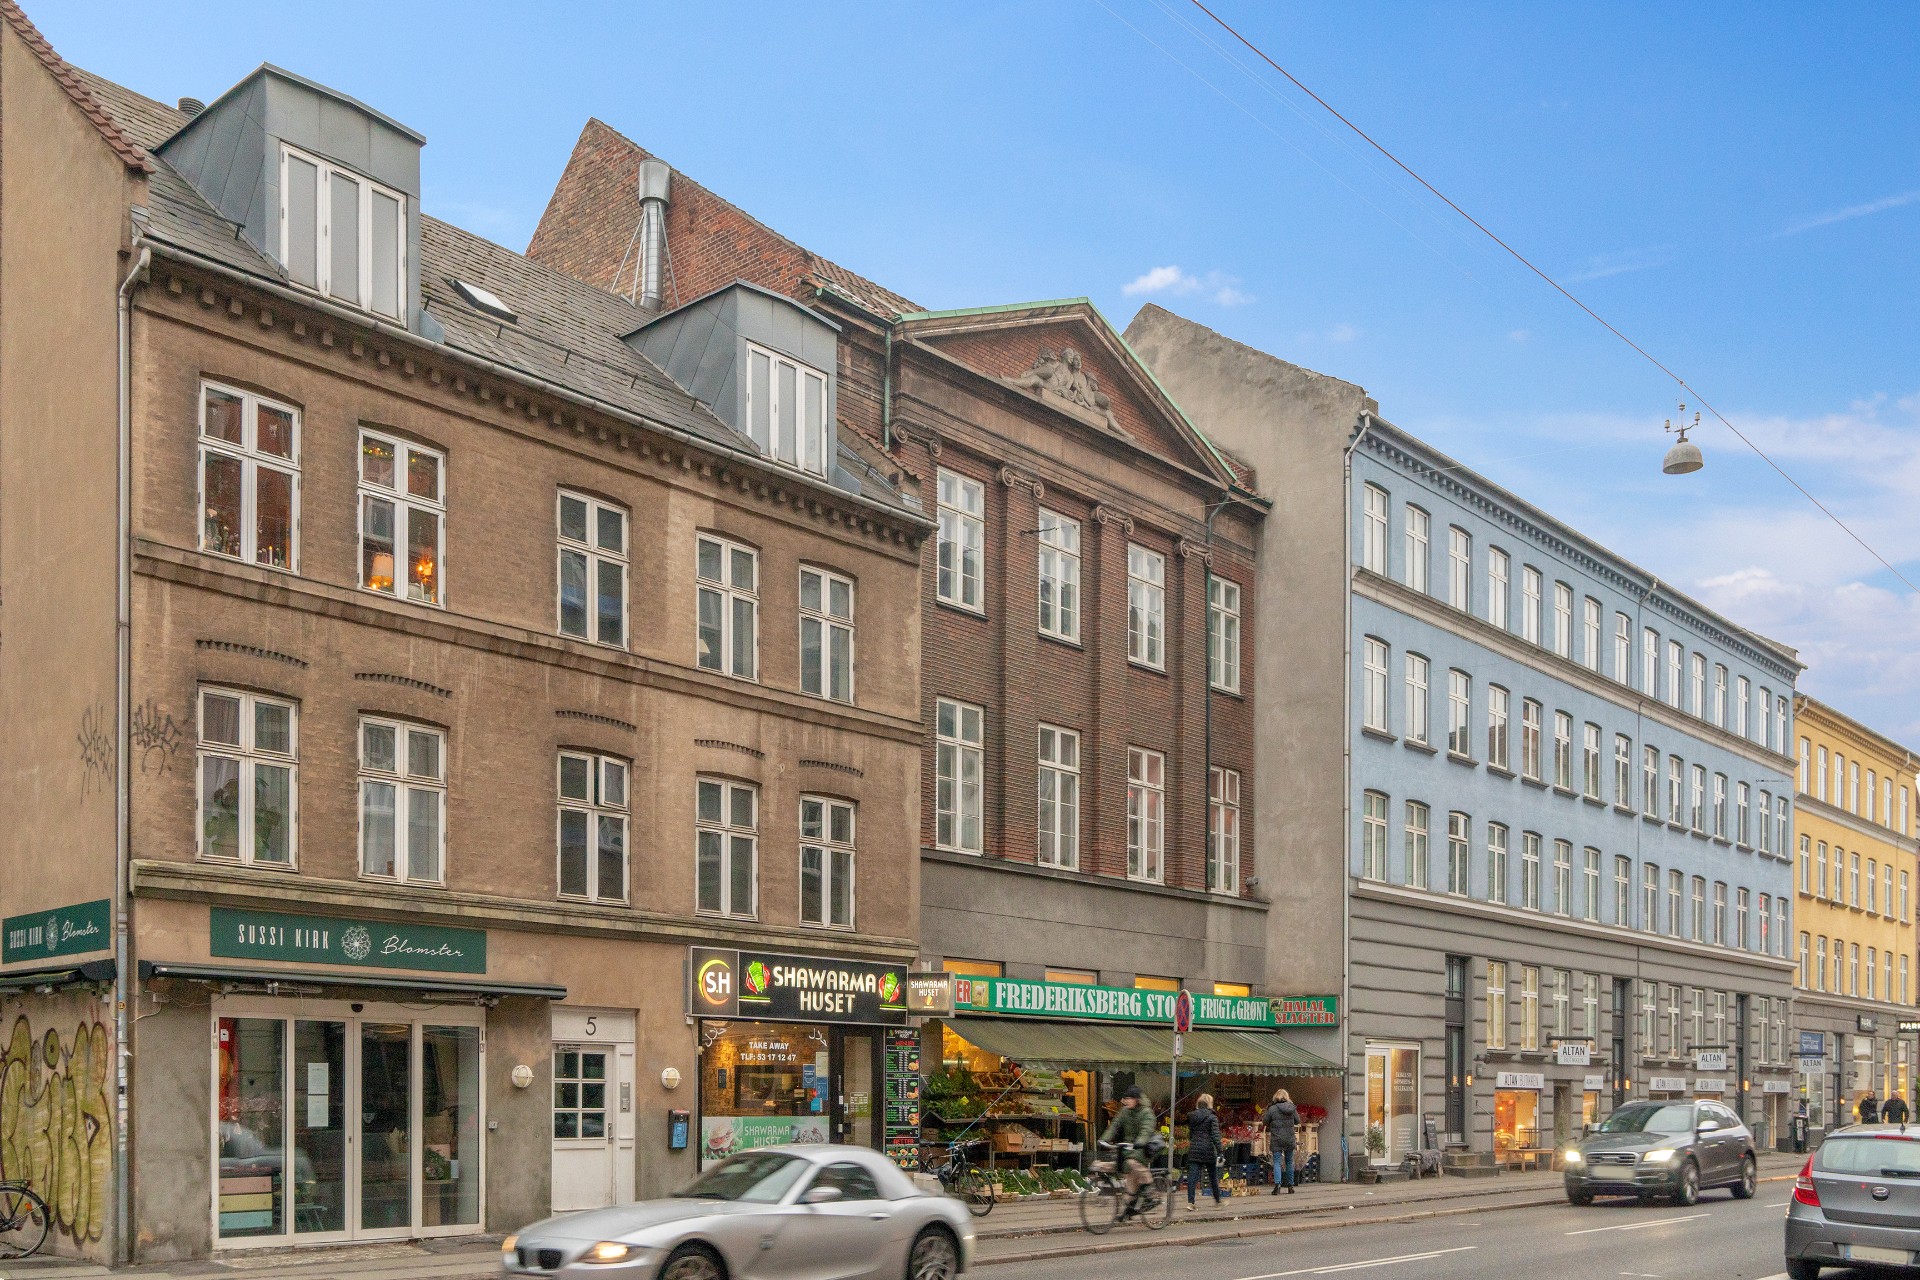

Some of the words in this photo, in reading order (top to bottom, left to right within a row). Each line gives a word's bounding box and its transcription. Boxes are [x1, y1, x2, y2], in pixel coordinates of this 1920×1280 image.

[61, 920, 99, 942] Blomster
[238, 923, 284, 946] SUSSI
[295, 928, 329, 950] KIRK
[380, 934, 464, 957] Blomster
[773, 966, 876, 993] SHAWARMA
[910, 980, 948, 990] SHAWARMA
[918, 988, 939, 998] HUSET
[800, 990, 856, 1013] HUSET
[995, 981, 1142, 1018] FREDERIKSBERG
[1283, 1000, 1326, 1012] HALAL
[1275, 1012, 1335, 1025] SLAGTER
[585, 1016, 597, 1036] 5
[749, 1041, 768, 1050] TAKE
[769, 1042, 790, 1050] AWAY
[1562, 1046, 1585, 1056] ALTAN
[741, 1053, 756, 1061] TLF:
[757, 1053, 766, 1061] 53
[767, 1053, 776, 1061] 17
[777, 1053, 786, 1061] 12
[787, 1054, 797, 1062] 47
[1701, 1053, 1722, 1062] ALTAN
[1802, 1059, 1821, 1067] ALTAN
[1504, 1074, 1518, 1086] ALTAN
[744, 1125, 790, 1136] SHAWARMA
[753, 1136, 781, 1147] HUSET
